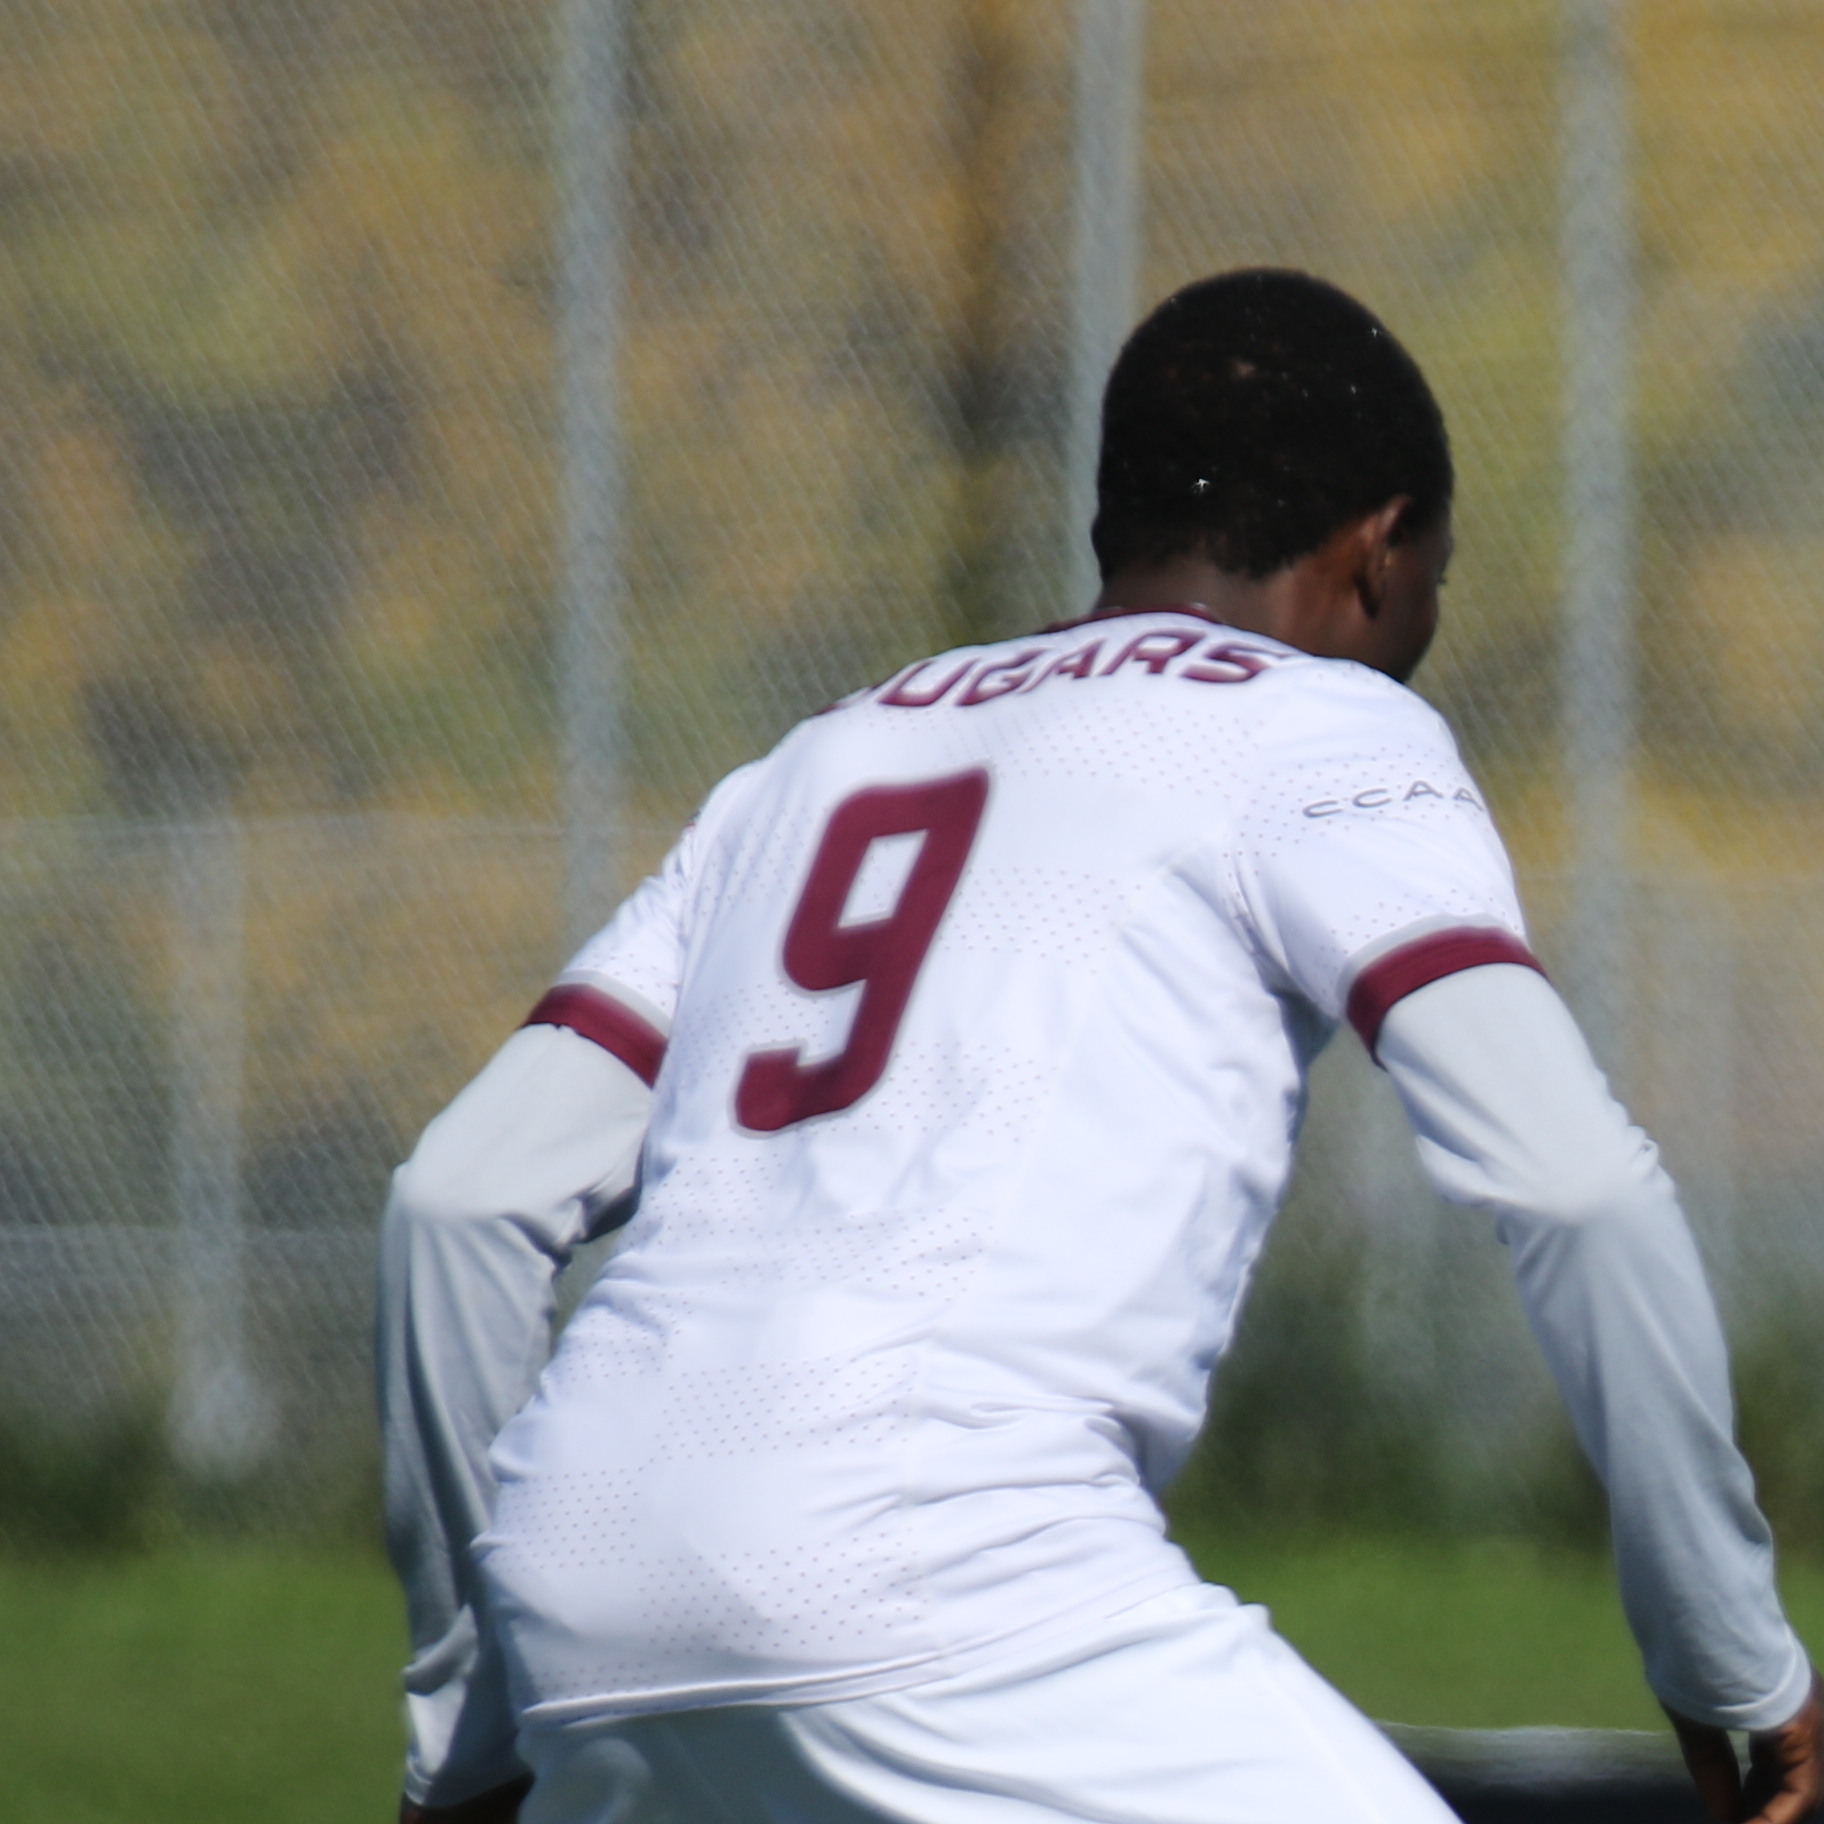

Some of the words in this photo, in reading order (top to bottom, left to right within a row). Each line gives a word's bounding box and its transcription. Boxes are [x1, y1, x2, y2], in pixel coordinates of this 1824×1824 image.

[814, 628, 1290, 712] UGARS
[1301, 779, 1485, 819] CCAA
[730, 762, 994, 1137] 9
